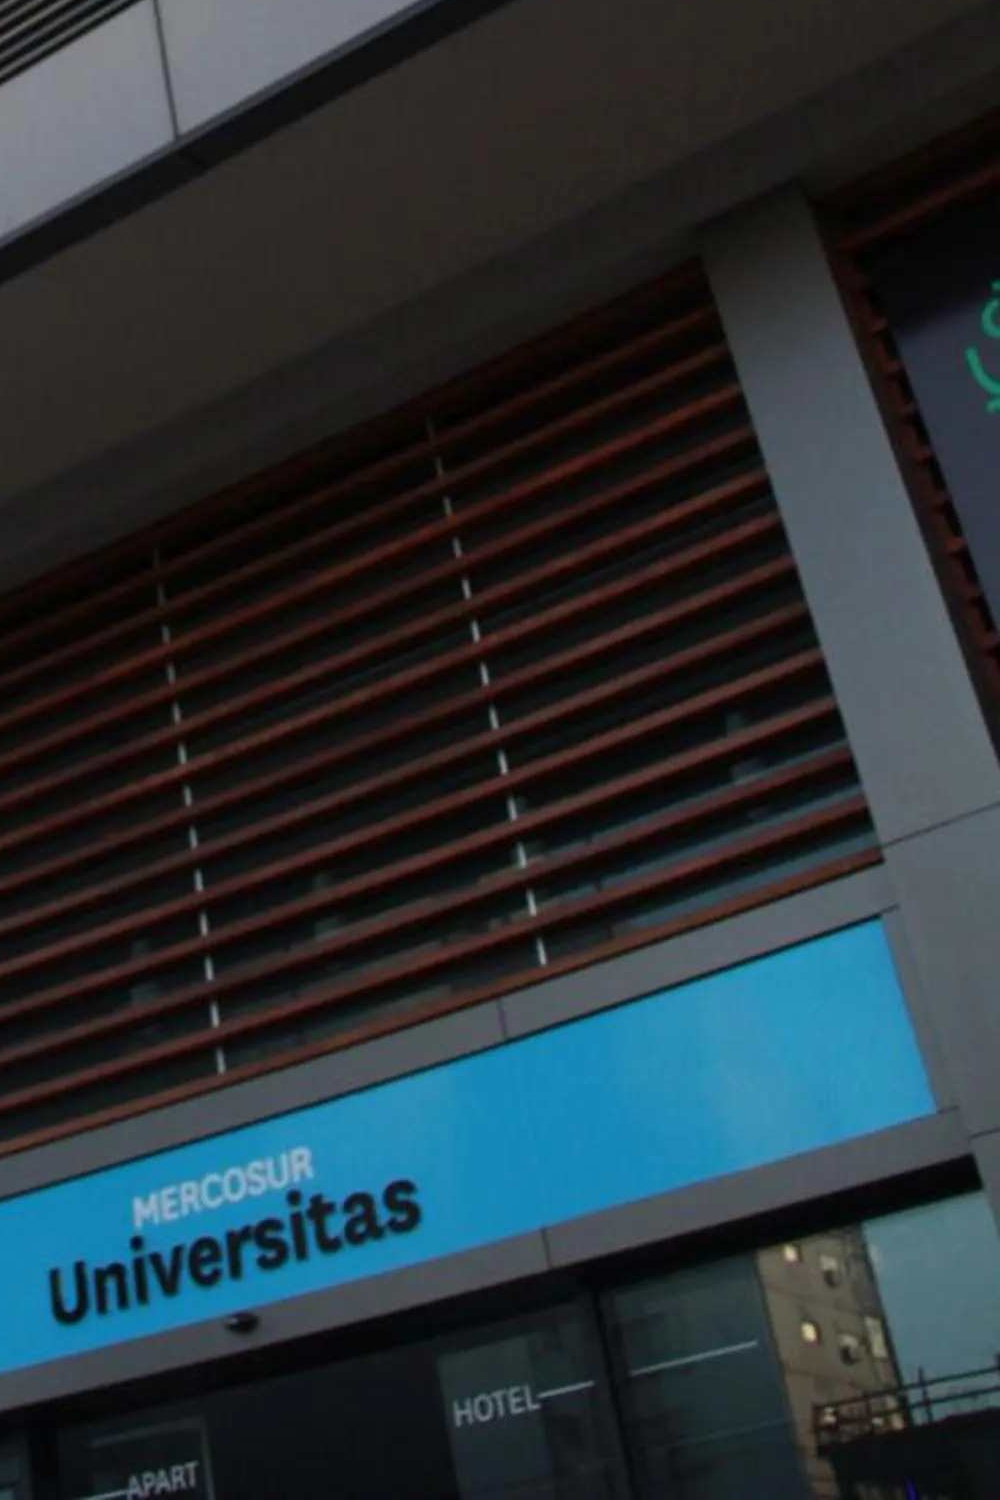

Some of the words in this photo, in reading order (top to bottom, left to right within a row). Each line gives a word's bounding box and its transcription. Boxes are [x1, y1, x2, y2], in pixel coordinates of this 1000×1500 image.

[132, 1146, 314, 1229] MERCOSUR
[49, 1179, 423, 1326] Universitas
[453, 1384, 540, 1428] HOTEL
[126, 1461, 199, 1500] APART
